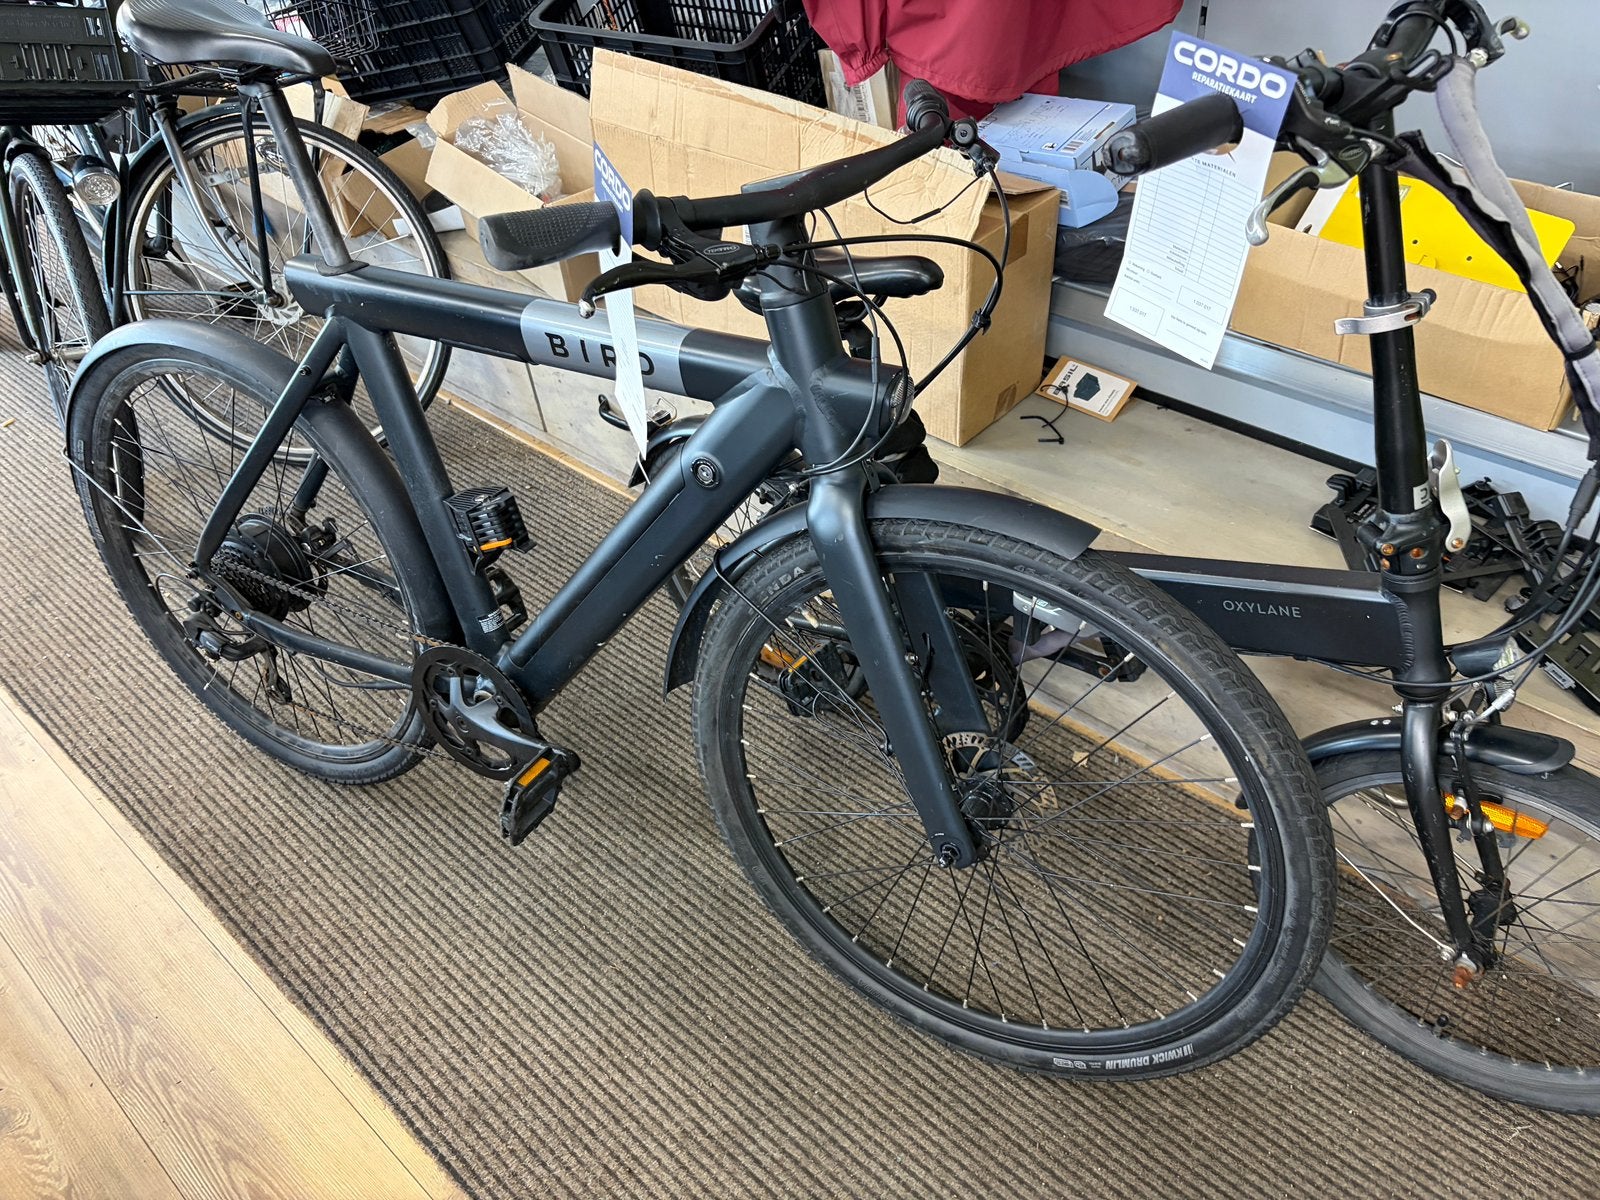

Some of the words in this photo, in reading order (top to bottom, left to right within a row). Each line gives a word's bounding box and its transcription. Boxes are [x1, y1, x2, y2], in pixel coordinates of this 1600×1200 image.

[1173, 40, 1287, 100] CORDO
[1192, 71, 1257, 104] REPARATIEKAART
[594, 149, 631, 211] CORDO
[544, 332, 655, 376] BIRD
[1222, 600, 1302, 618] OXYLANE
[1105, 1055, 1150, 1070] DRUMLIN
